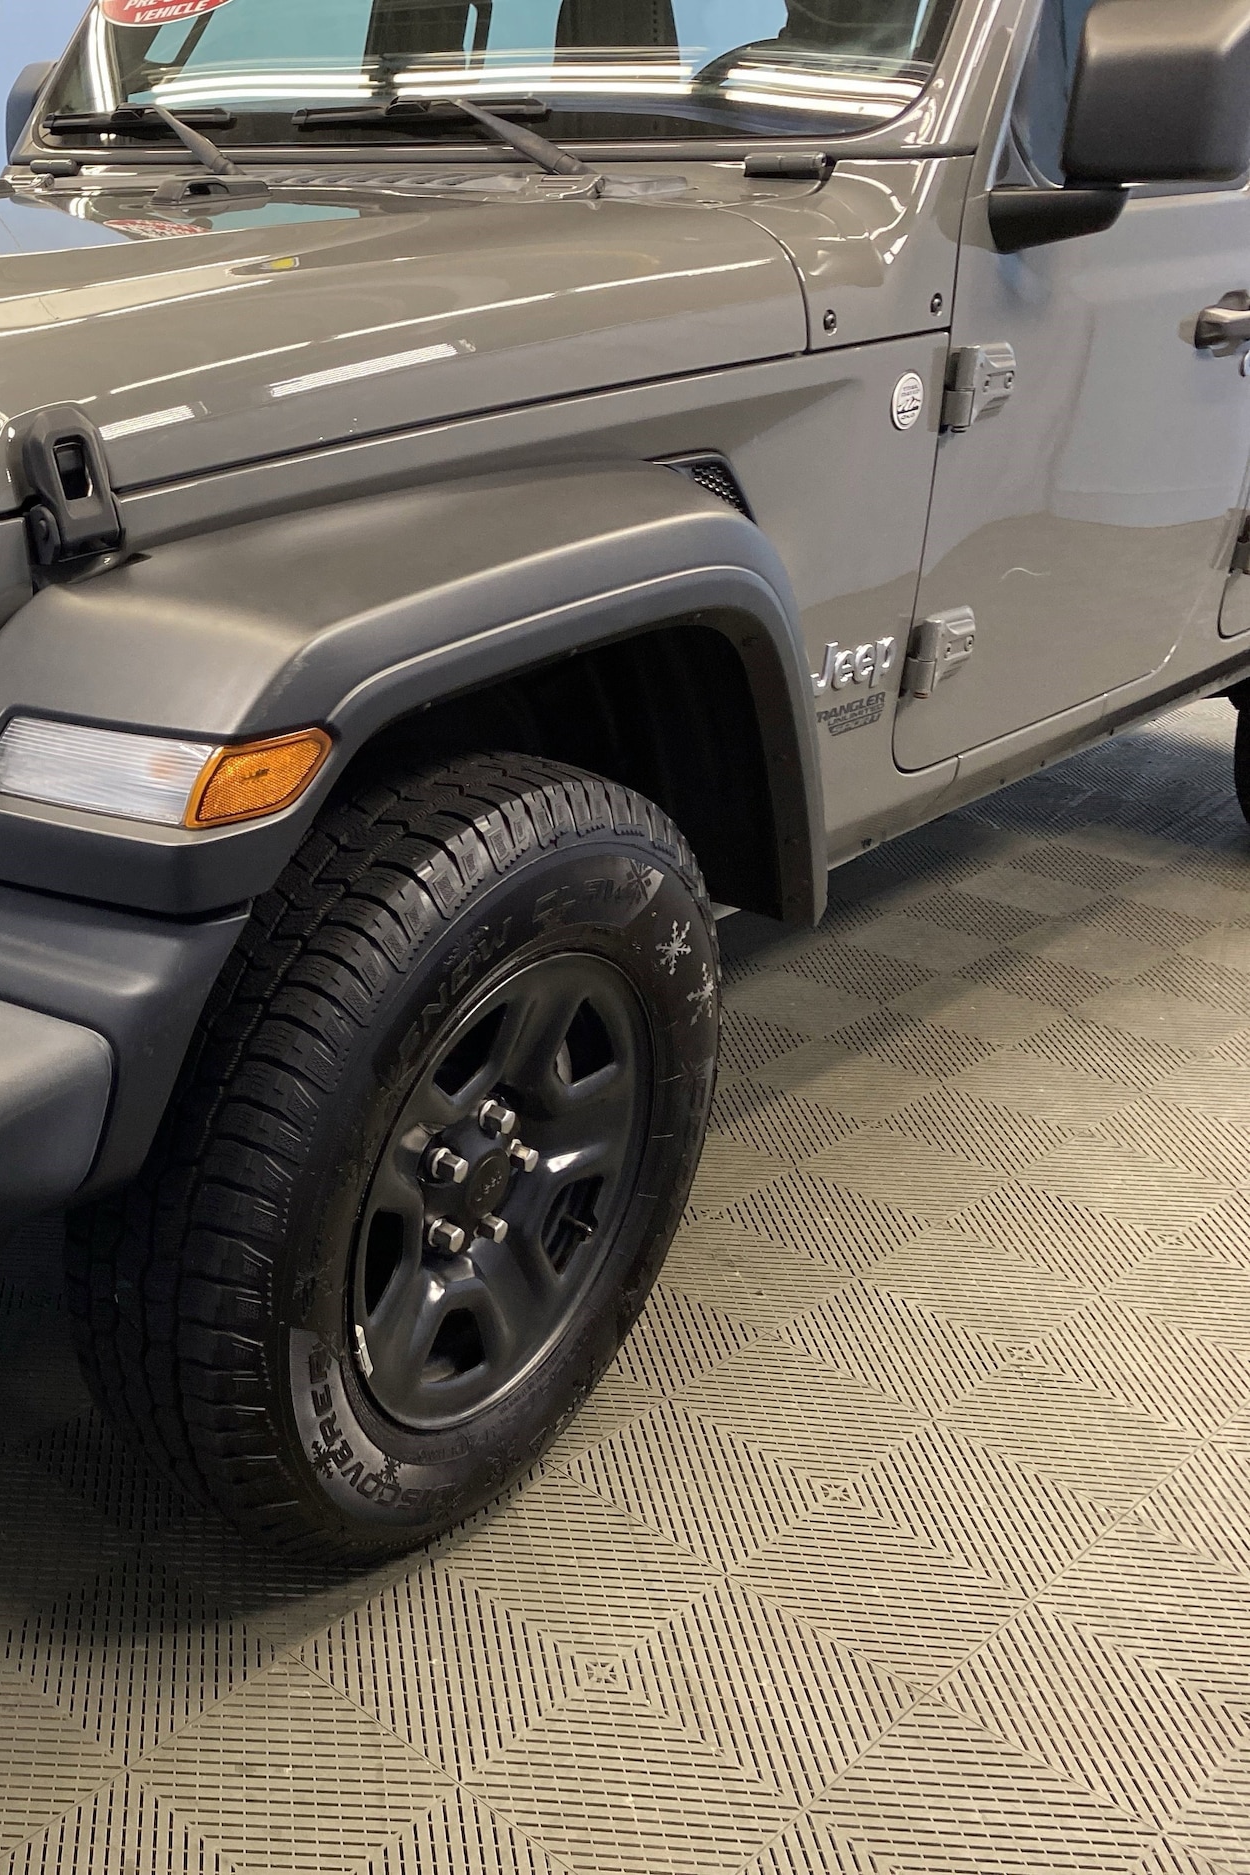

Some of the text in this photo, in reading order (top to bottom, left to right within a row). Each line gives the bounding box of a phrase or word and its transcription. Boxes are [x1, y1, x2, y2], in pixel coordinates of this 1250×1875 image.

[134, 0, 209, 23] VEHICLE
[810, 636, 897, 697] Jeep
[816, 692, 886, 723] RANGLER
